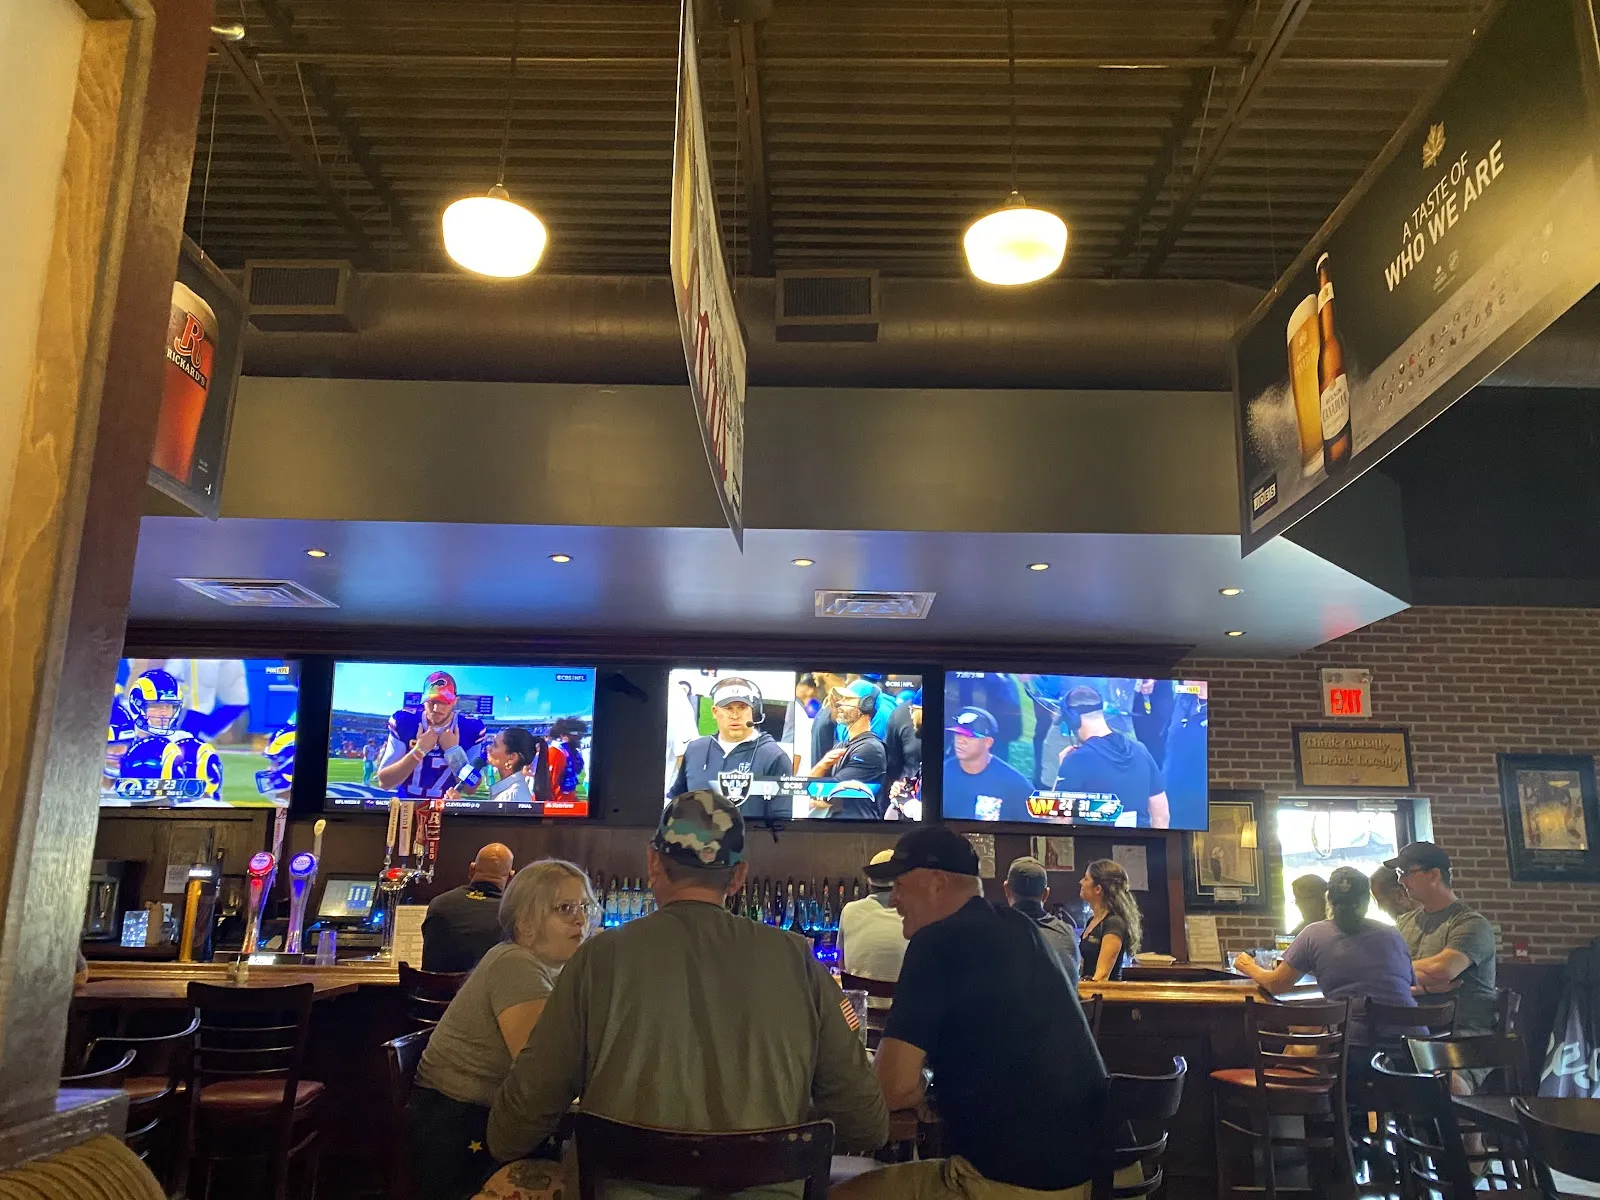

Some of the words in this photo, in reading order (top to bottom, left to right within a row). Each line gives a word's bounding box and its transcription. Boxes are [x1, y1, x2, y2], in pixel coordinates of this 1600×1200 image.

[1402, 222, 1412, 244] A
[1412, 175, 1449, 230] TASTE
[1450, 151, 1468, 186] OF
[1384, 232, 1425, 292] WHO
[1428, 192, 1459, 245] WE
[1463, 139, 1505, 212] ARE
[174, 311, 204, 368] R
[166, 347, 206, 387] RICKARD'S
[1330, 688, 1362, 715] EXIT
[1304, 737, 1341, 750] Think
[146, 780, 159, 790] 23
[163, 780, 177, 790] 23
[1059, 800, 1073, 811] 24
